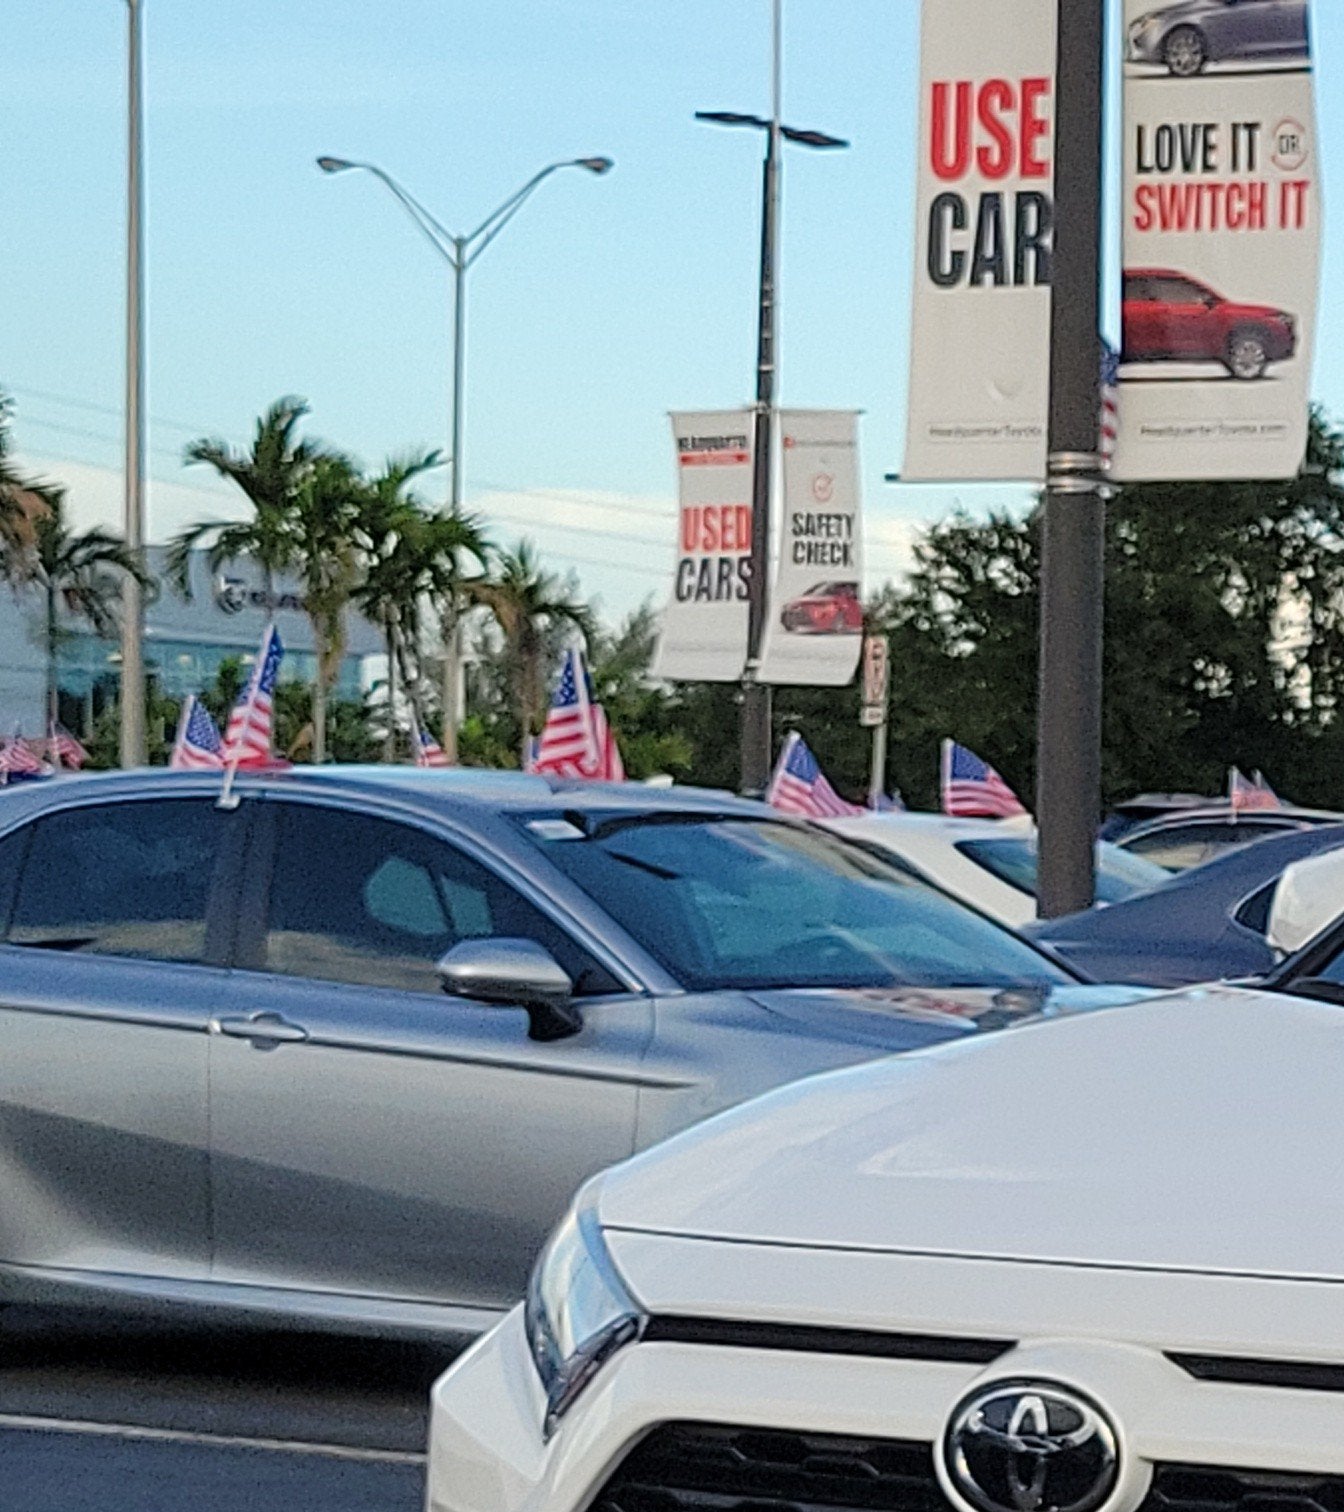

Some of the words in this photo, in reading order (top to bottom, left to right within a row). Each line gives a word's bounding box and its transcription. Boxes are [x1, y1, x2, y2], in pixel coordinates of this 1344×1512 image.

[931, 78, 1051, 180] USE
[1136, 123, 1217, 174] LOVE
[1230, 122, 1260, 173] IT
[1135, 181, 1266, 232] SWITCH
[1280, 180, 1309, 229] IT
[927, 191, 1052, 287] CAR
[683, 506, 750, 552] USED
[793, 512, 854, 537] SAFETY
[793, 540, 853, 566] CHECK
[676, 557, 753, 602] CARS
